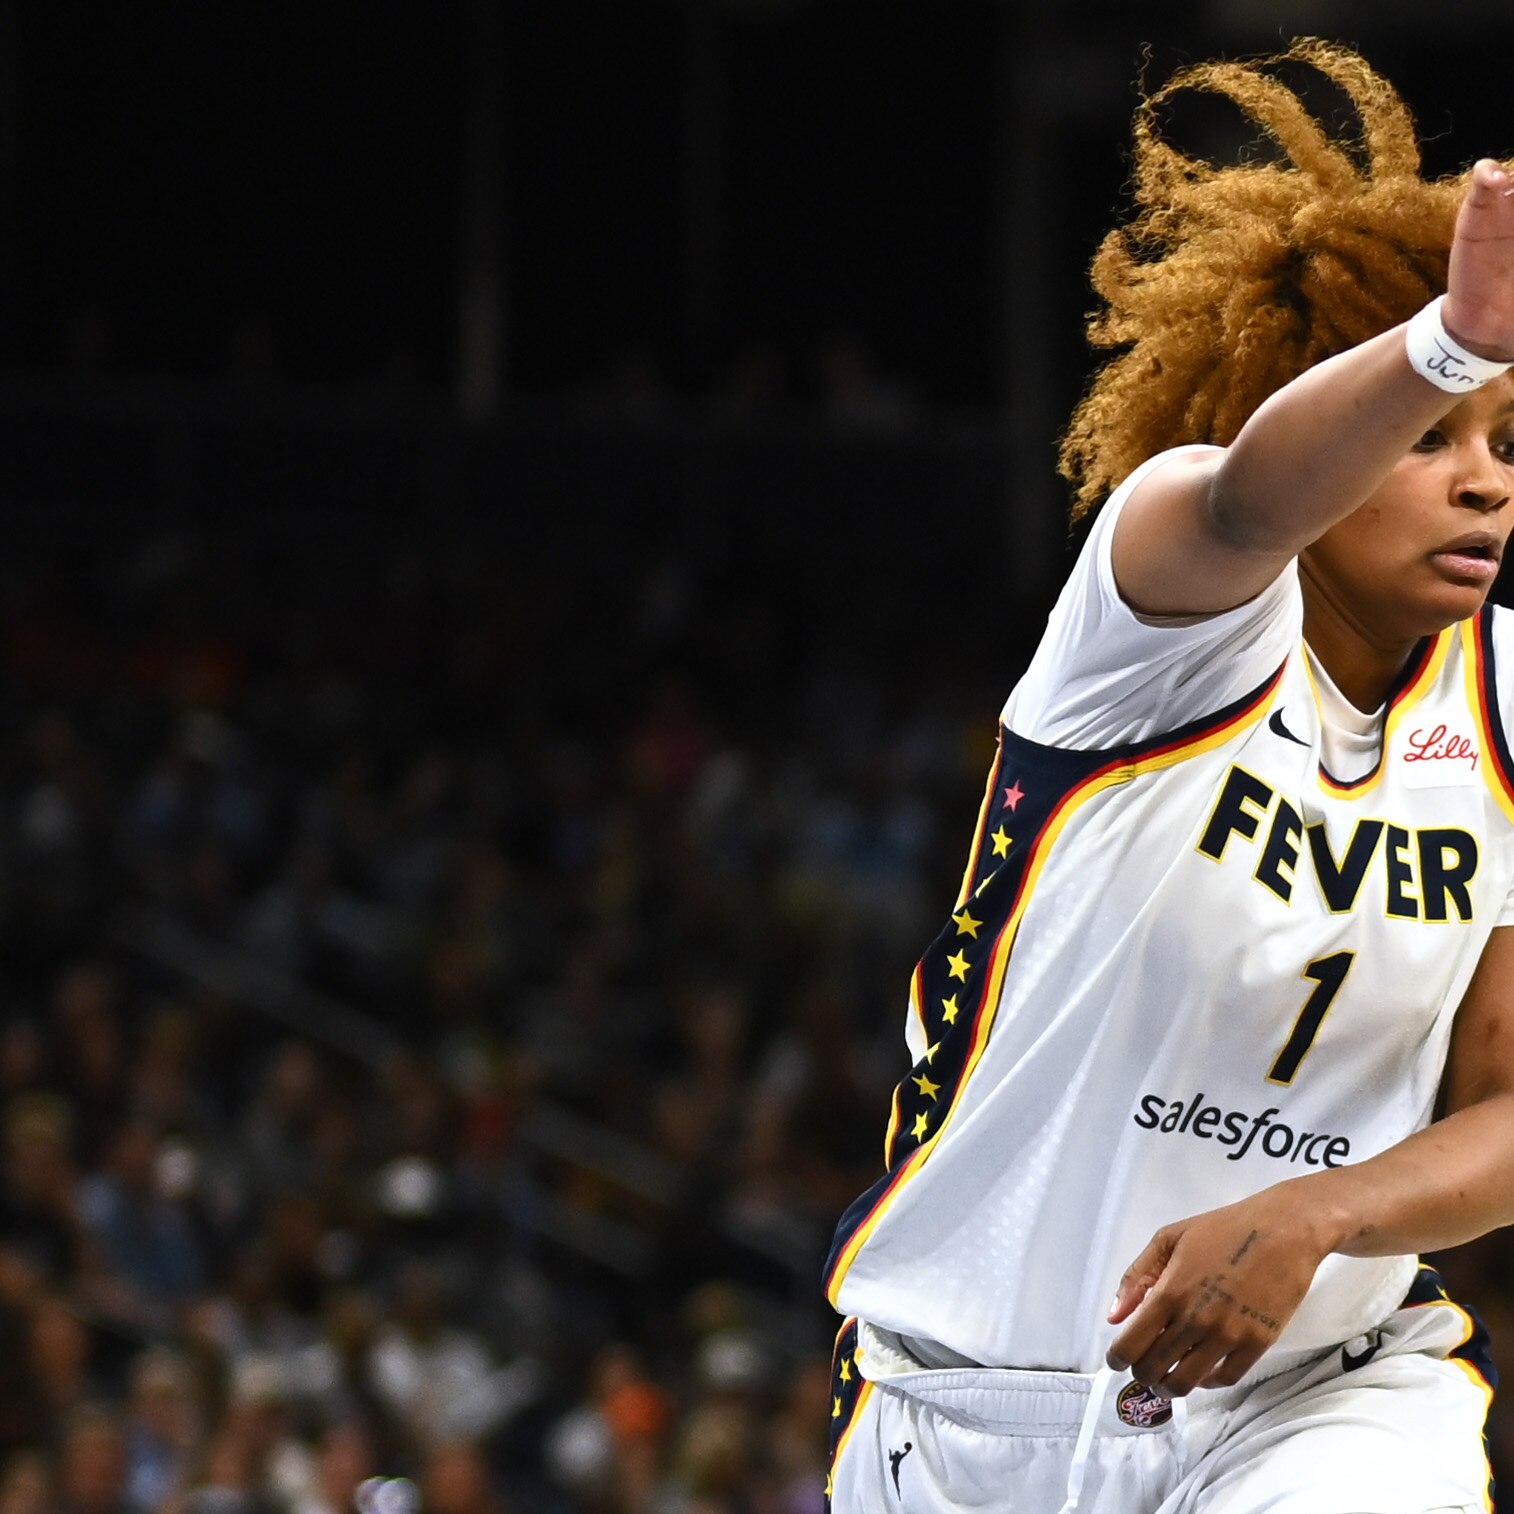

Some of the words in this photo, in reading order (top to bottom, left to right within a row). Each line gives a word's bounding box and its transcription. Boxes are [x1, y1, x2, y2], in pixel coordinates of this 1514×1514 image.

[1403, 724, 1478, 771] Lilly
[1194, 762, 1478, 923] FEVER
[1264, 948, 1357, 1087] 1
[1134, 1093, 1350, 1168] salesforce
